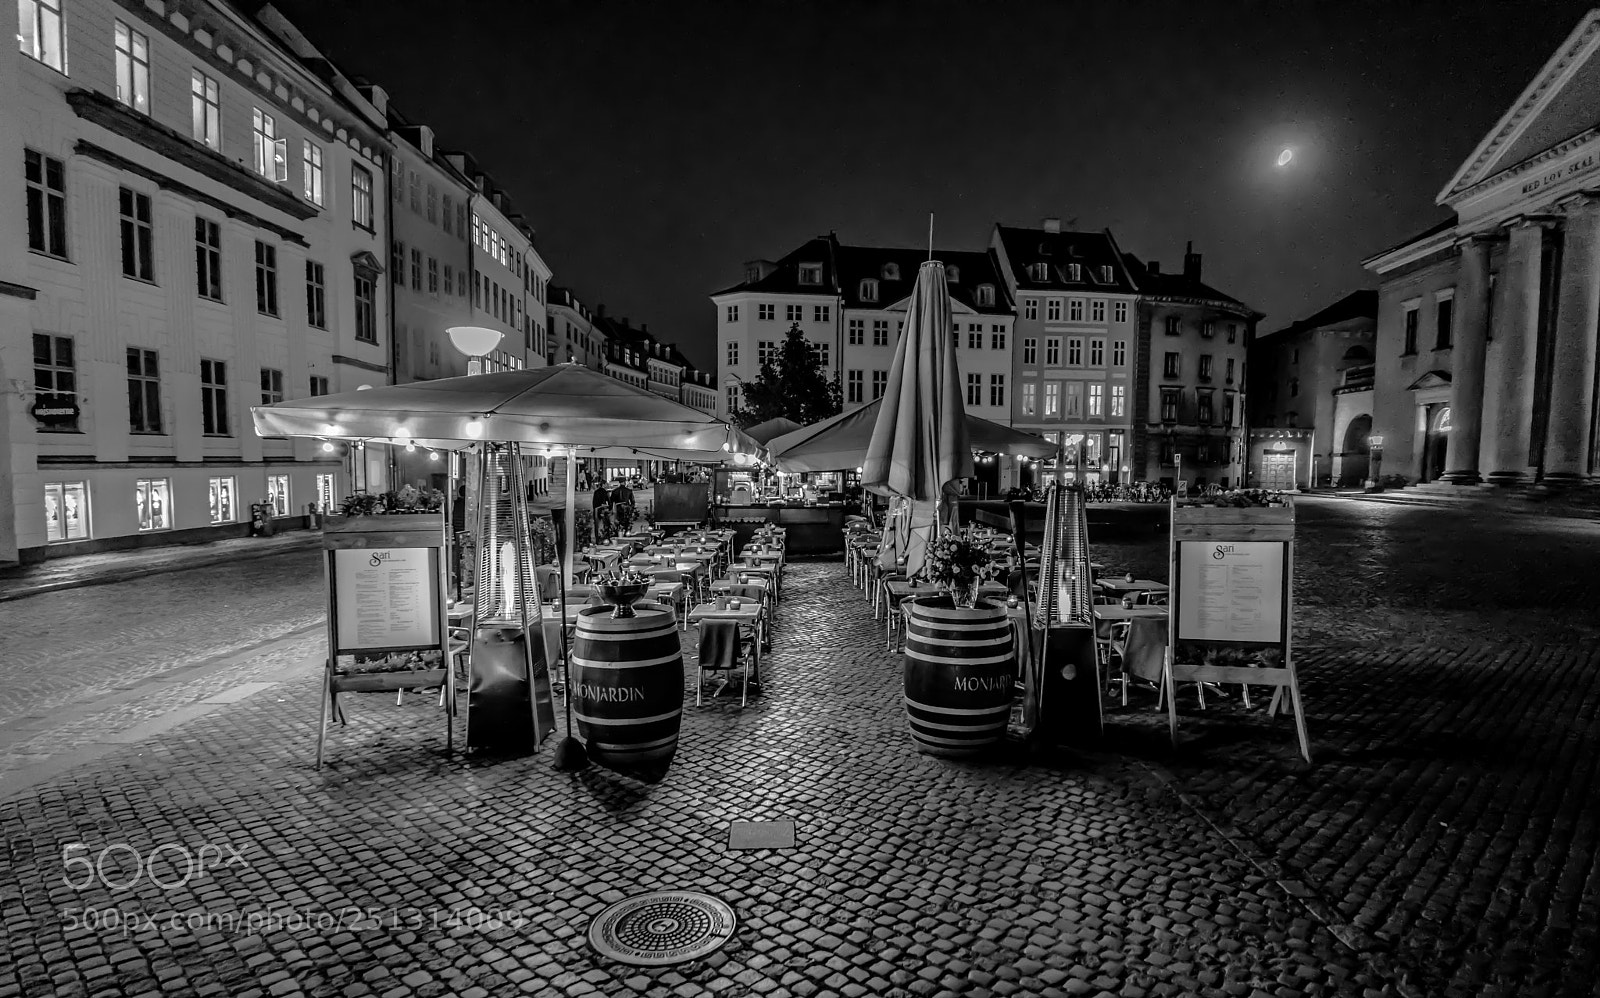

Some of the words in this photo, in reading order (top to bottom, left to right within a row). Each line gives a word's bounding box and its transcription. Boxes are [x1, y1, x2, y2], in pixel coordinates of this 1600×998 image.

[1522, 180, 1540, 194] MED
[1543, 169, 1563, 185] LOV
[1568, 155, 1595, 175] SKAL
[369, 550, 391, 567] Sari
[1212, 543, 1235, 560] Sari
